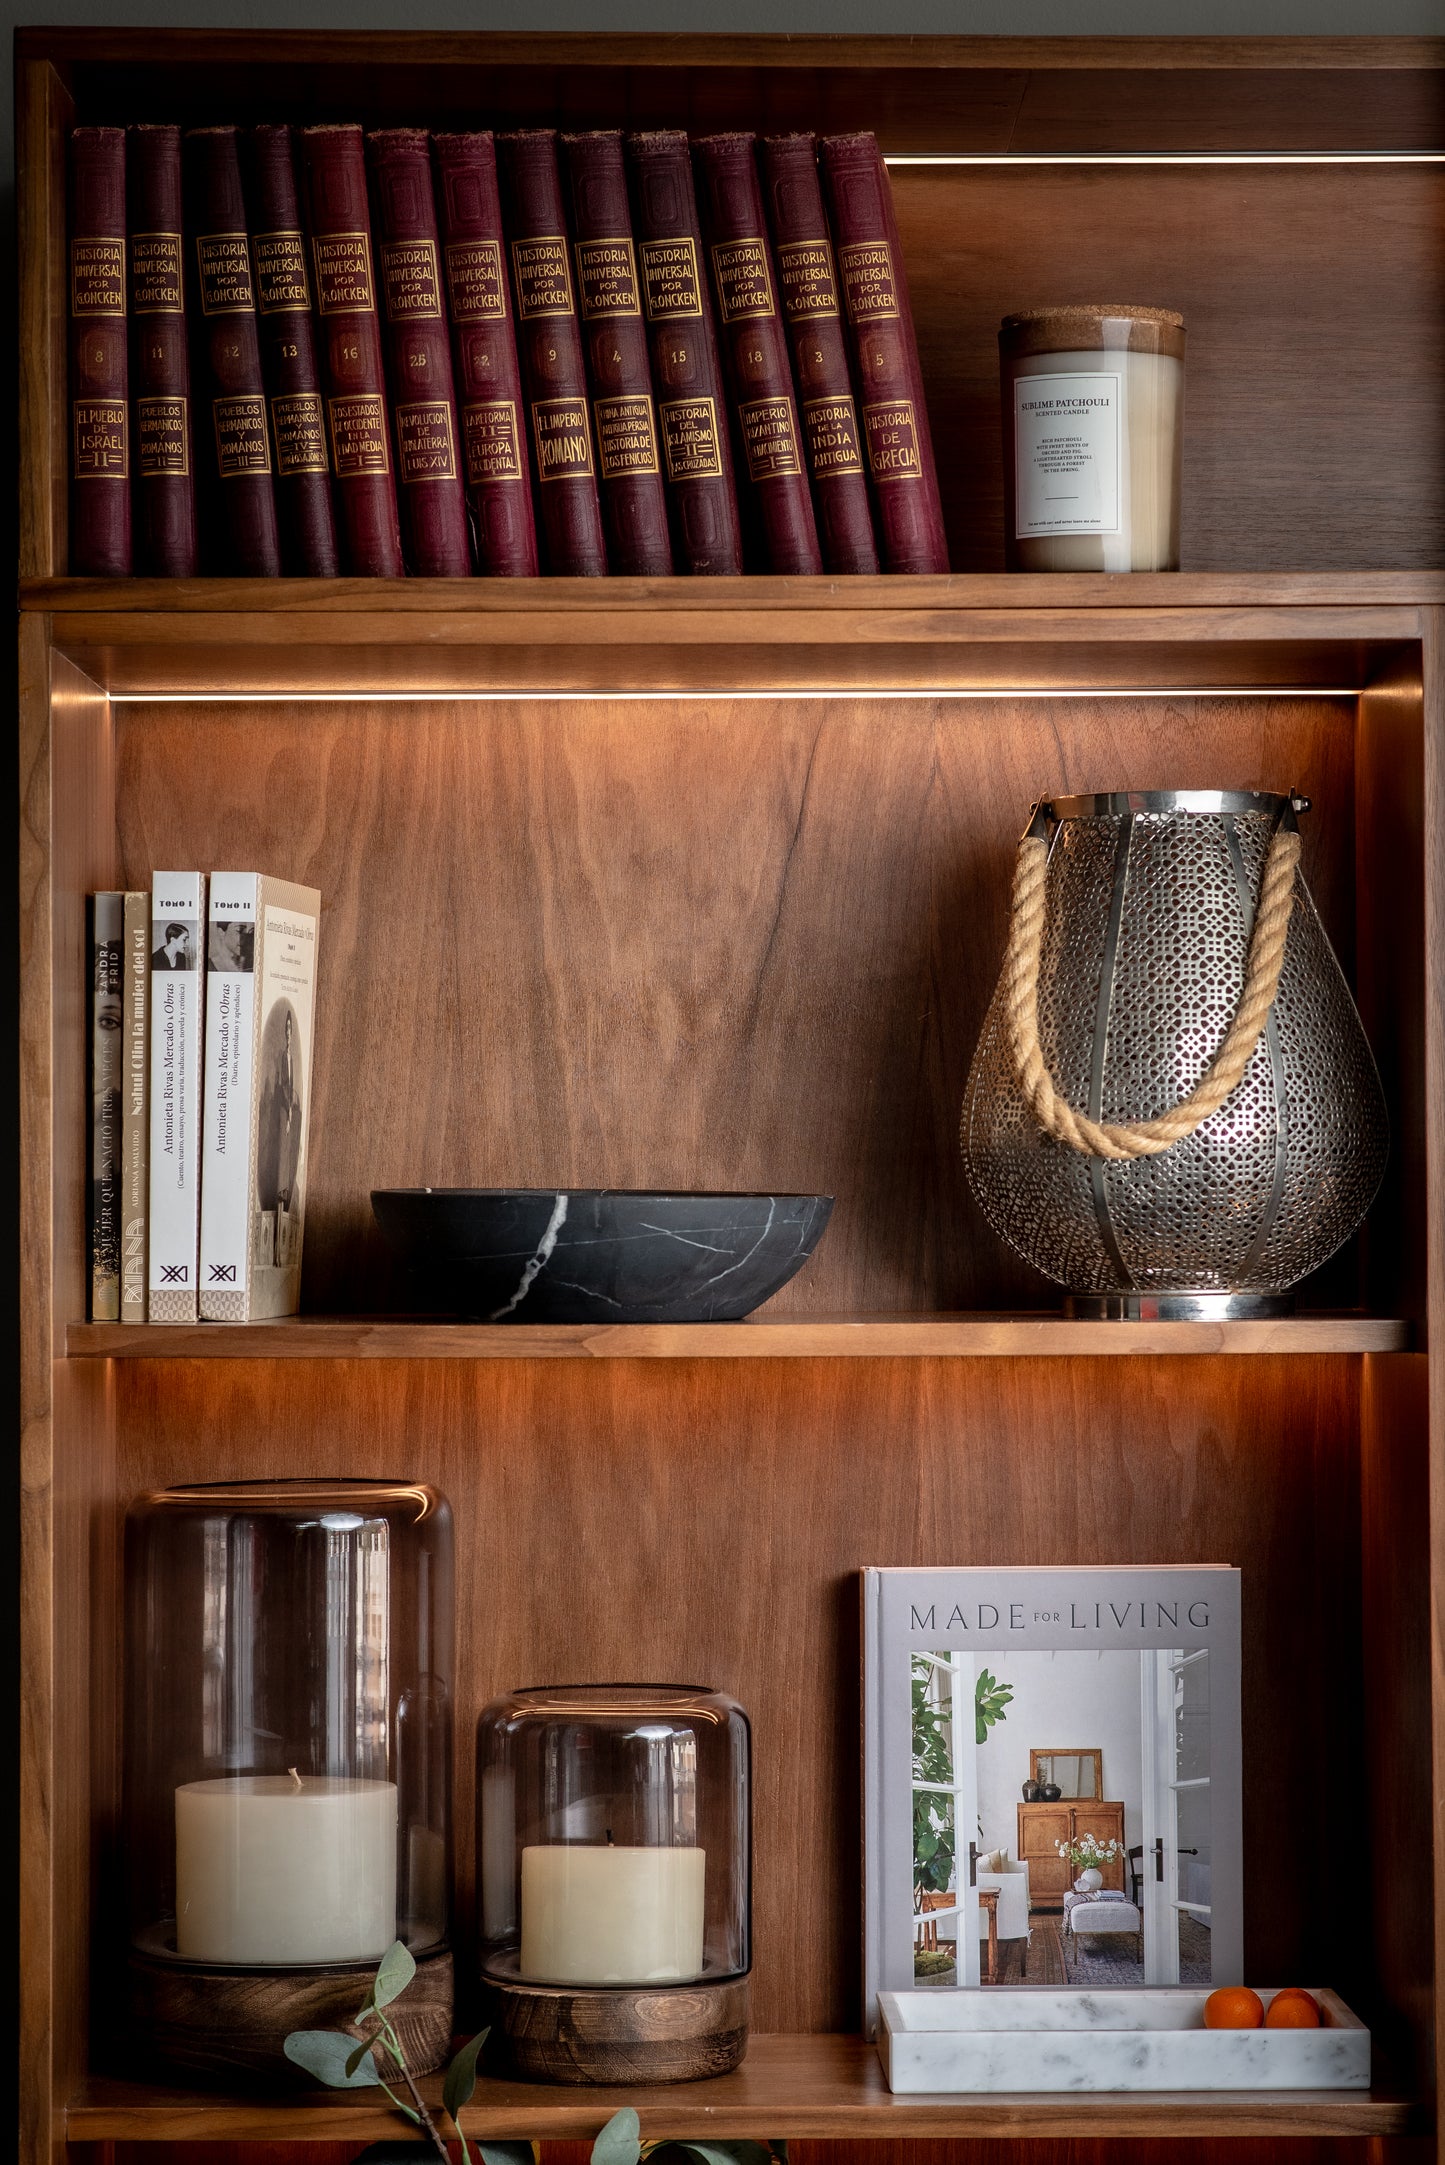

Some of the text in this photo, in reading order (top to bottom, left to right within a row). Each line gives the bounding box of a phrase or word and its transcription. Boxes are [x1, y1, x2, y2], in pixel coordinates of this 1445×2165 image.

[76, 248, 120, 260] HISTORIA
[134, 243, 177, 256] HISTORIA
[203, 243, 247, 258] HISTORIA
[257, 241, 301, 258] HISTORIA
[320, 243, 364, 258] HISTORIA
[519, 247, 563, 262] HISTORIA
[646, 248, 690, 264] HISTORIA
[584, 250, 627, 265] HISTORIA
[782, 252, 825, 268] HISTORIA
[845, 252, 887, 268] HISTORIA
[75, 265, 120, 277] UNIVERSAL
[134, 260, 178, 274] UNIVERSAL
[203, 260, 249, 275] UNIVERSAL
[321, 260, 365, 274] UNIVERSAL
[520, 264, 564, 279] UNIVERSAL
[584, 267, 631, 281] UNIVERSAL
[646, 265, 692, 281] UNIVERSAL
[720, 265, 764, 283] UNIVERSAL
[217, 277, 238, 285] POR
[272, 275, 294, 284] POR
[335, 276, 355, 285] POR
[783, 268, 830, 284] UNIVERSAL
[846, 268, 891, 285] UNIVERSAL
[89, 280, 109, 288] POR
[401, 284, 422, 292] POR
[466, 284, 487, 293] POR
[534, 280, 555, 289] POR
[600, 282, 618, 290] POR
[662, 282, 682, 291] POR
[735, 282, 755, 292] POR
[800, 284, 817, 292] POR
[861, 284, 881, 293] POR
[95, 351, 103, 363] 8
[152, 346, 164, 359] 11
[282, 345, 298, 358] 13
[343, 347, 359, 360] 16
[549, 349, 557, 361] 9
[612, 351, 621, 362] 4
[672, 350, 686, 363] 15
[749, 351, 763, 363] 18
[815, 352, 823, 363] 3
[876, 354, 883, 366] 5
[142, 407, 180, 417] PUEBLOS
[220, 405, 259, 416] PUEBLOS
[1021, 399, 1109, 411] SUBLIME PATCHOULI
[79, 410, 123, 424] EL PUEBLO
[550, 413, 582, 428] IMPERIO
[666, 408, 709, 422] HISTORIA
[745, 407, 786, 424] IMPERIO
[808, 407, 850, 424] HISTORIA
[868, 412, 911, 430] HISTORIA
[94, 424, 108, 434] DE
[418, 427, 430, 436] DE
[480, 426, 496, 437] II
[680, 421, 697, 430] DEL
[82, 435, 123, 449] ISRAEL
[158, 432, 166, 440] Y
[360, 431, 370, 439] LA
[813, 433, 851, 449] INDIA
[882, 432, 900, 444] DE
[142, 442, 183, 455] ROMANOS
[221, 441, 264, 455] ROMANOS
[295, 443, 307, 451] IV
[360, 440, 382, 452] MEDIA
[541, 436, 587, 466] ROMANO
[604, 436, 650, 453] HISTORIA DE
[685, 444, 698, 456] II
[93, 451, 109, 467] II
[157, 456, 167, 466] II
[237, 456, 249, 466] III
[358, 455, 363, 466] I
[408, 456, 448, 470] LUIS XIV
[769, 456, 776, 468] I
[815, 450, 857, 468] ANTIGUA
[874, 448, 916, 470] GRECIA
[99, 941, 108, 996] SANDRA
[110, 952, 119, 984] FRID
[178, 983, 186, 1010] crónica)
[131, 929, 145, 1115] Nahui Olin la mujer del sol
[232, 1025, 241, 1060] epistolario
[163, 983, 174, 1154] Antonieta Rivas Mercado Obras
[216, 984, 230, 1154] Antonieta Rivas Mercado Obras
[231, 1060, 240, 1086] (Diario,
[178, 1115, 186, 1138] ensayo,
[101, 1038, 114, 1254] MUJER QUE NACIÓ TRES VECES
[177, 1161, 185, 1189] (Cuento,
[124, 1218, 144, 1303] DIANA
[910, 1602, 1210, 1630] MADE FOR LIVING
